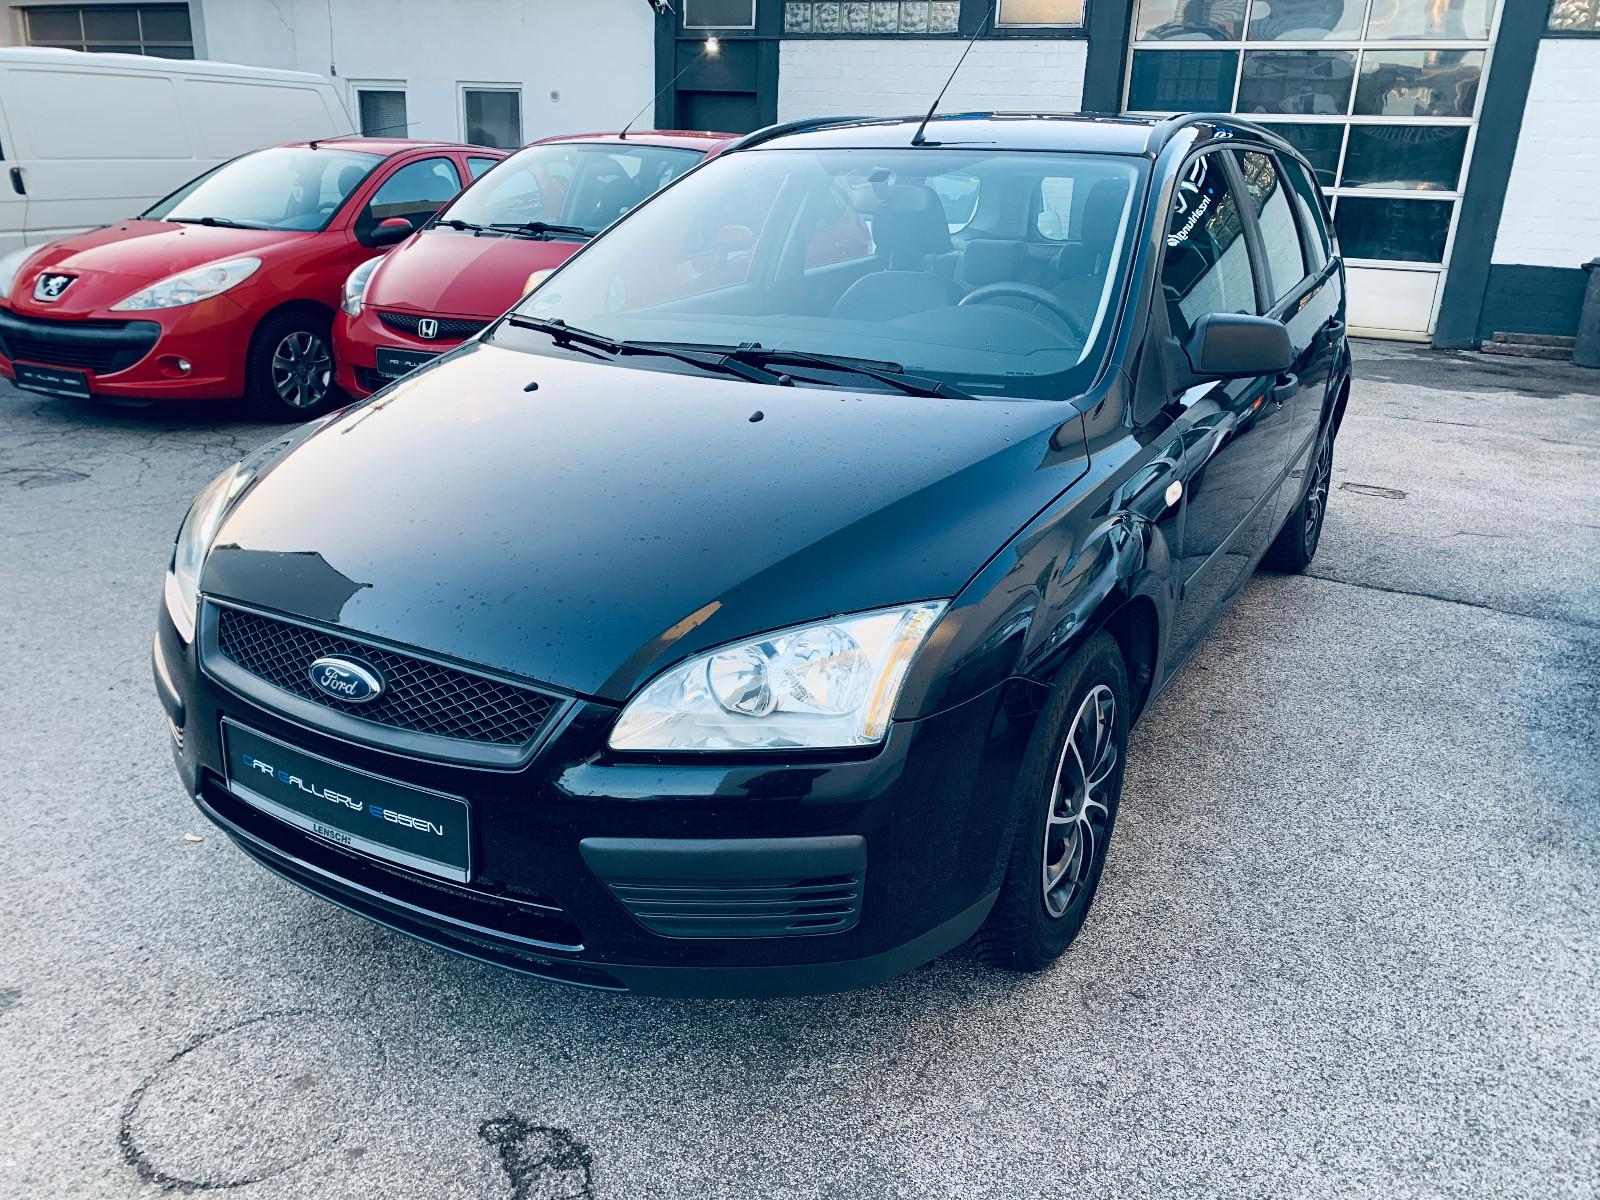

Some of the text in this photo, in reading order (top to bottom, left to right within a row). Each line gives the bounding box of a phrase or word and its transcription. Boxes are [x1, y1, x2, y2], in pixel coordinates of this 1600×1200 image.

[321, 667, 358, 695] Ford
[242, 753, 443, 836] CAR GALLERY ESSEN
